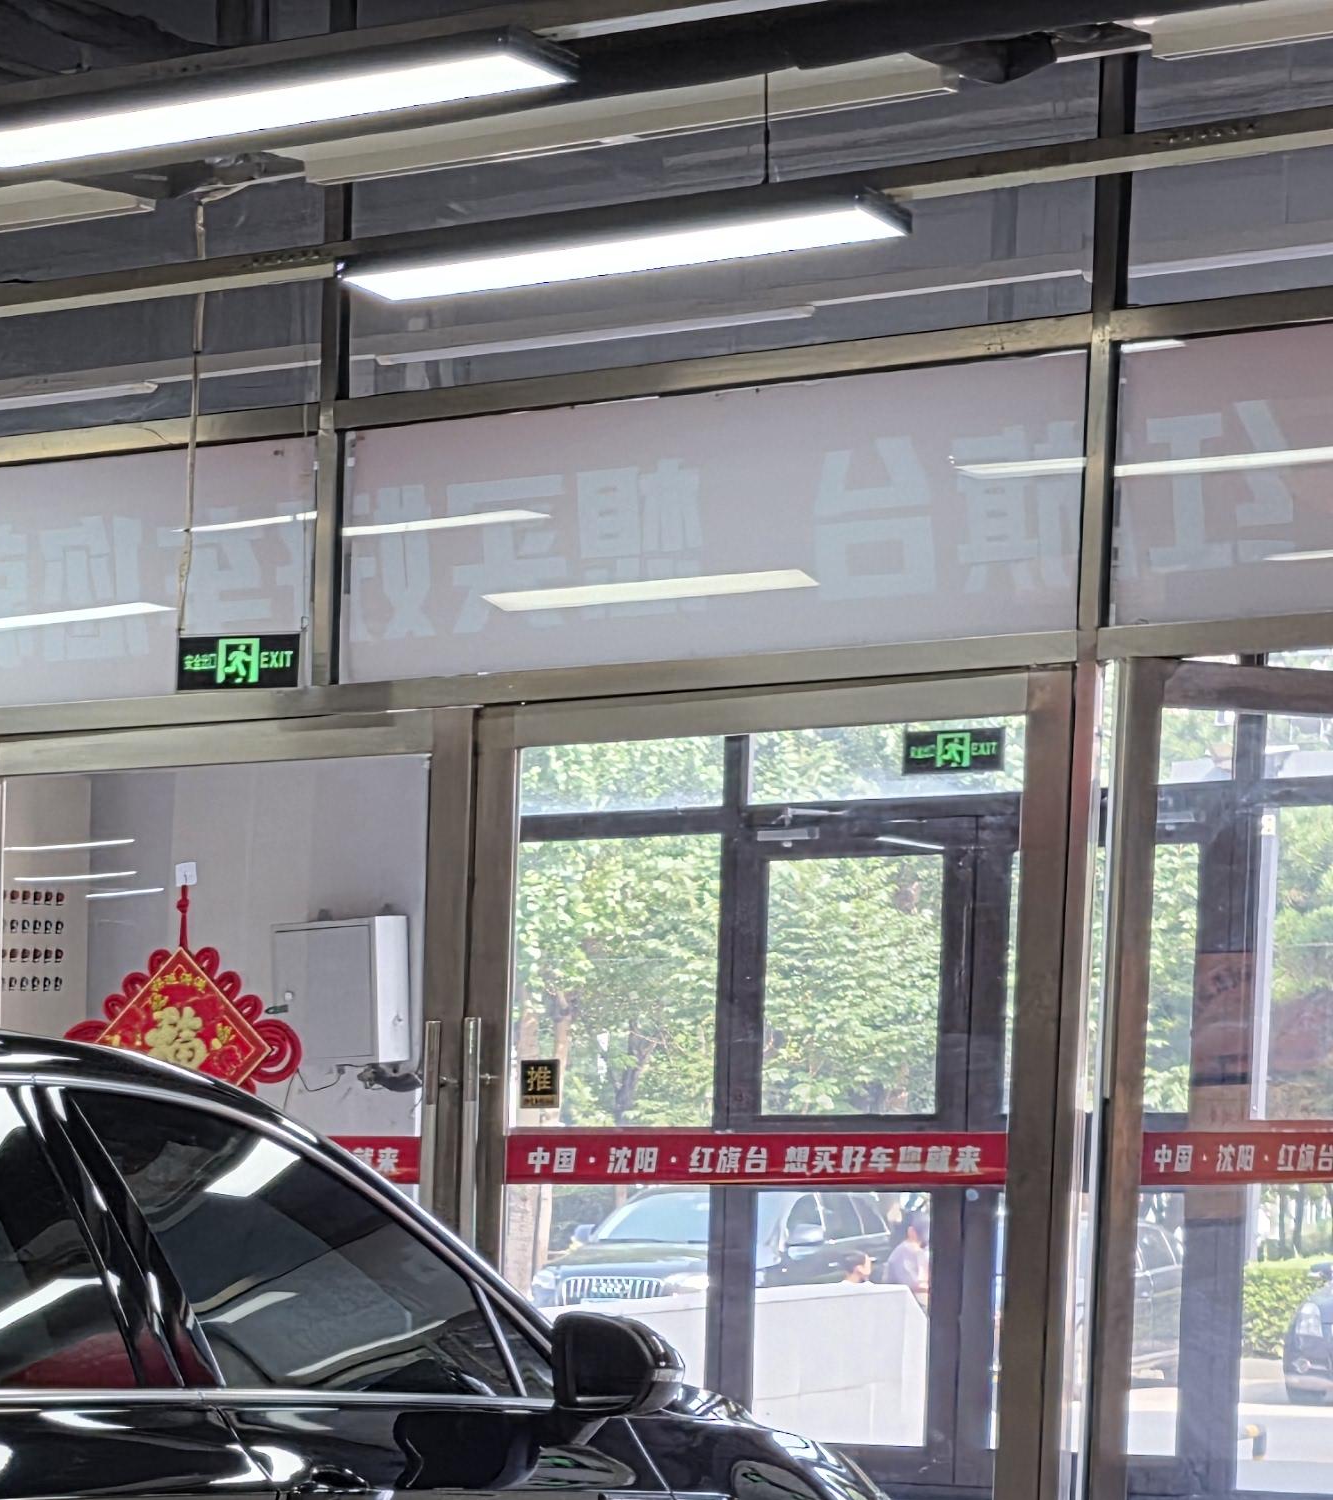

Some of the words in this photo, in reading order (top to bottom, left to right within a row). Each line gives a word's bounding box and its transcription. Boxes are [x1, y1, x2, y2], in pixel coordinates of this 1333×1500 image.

[260, 651, 293, 668] EXIT
[971, 742, 997, 756] EXIT
[527, 1065, 552, 1091] 推
[783, 1145, 981, 1174] 想买好车您就来
